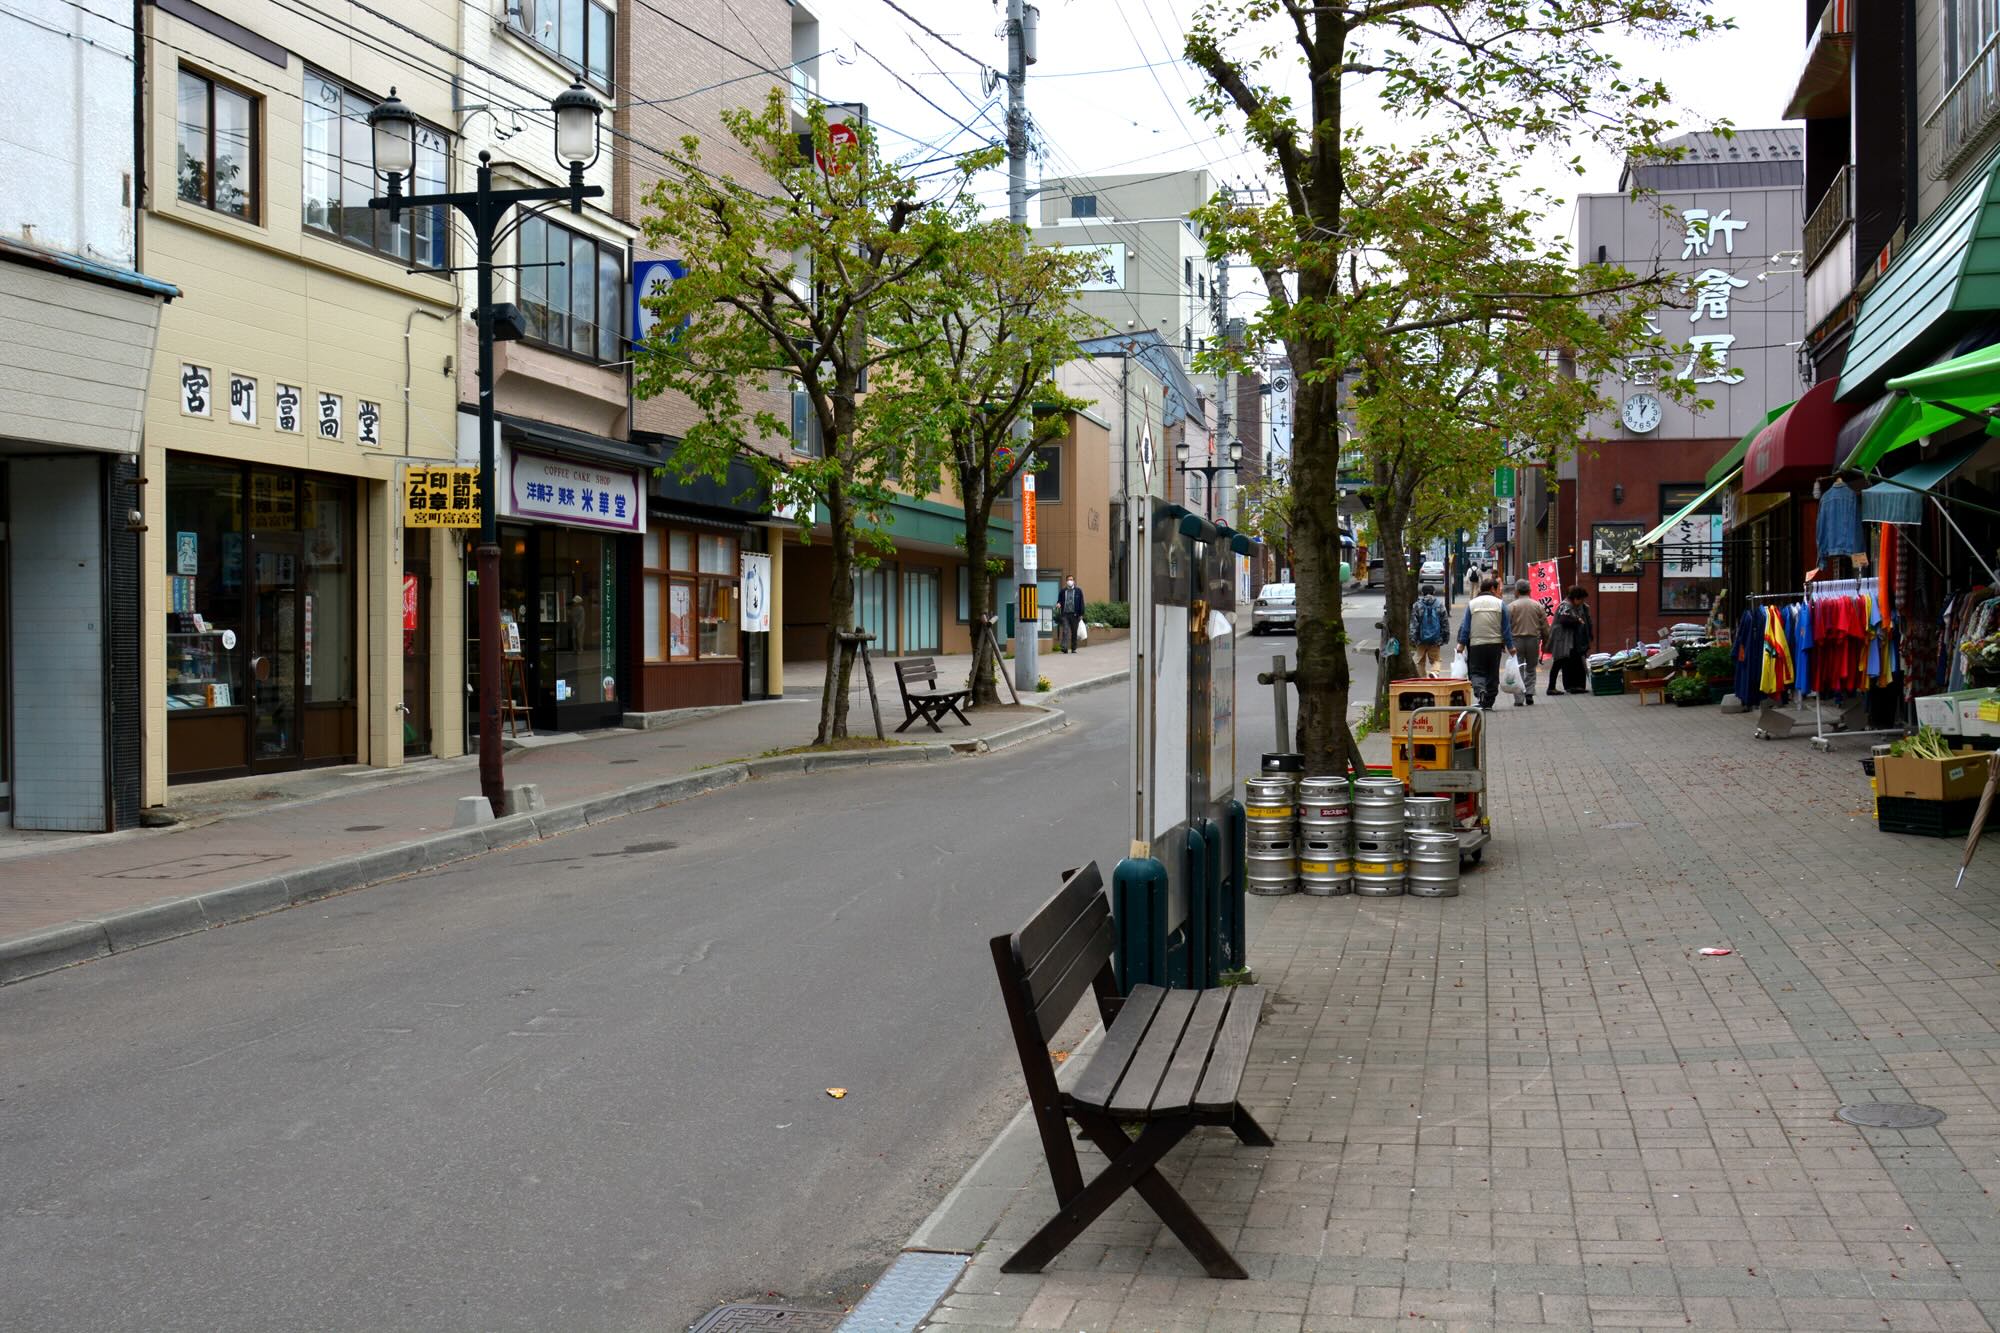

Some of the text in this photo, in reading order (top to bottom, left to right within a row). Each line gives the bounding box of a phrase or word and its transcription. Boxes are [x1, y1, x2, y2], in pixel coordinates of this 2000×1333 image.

[1677, 208, 1750, 385] 新倉屋
[182, 365, 379, 445] 宮町富高堂
[409, 471, 429, 510] ゴム印
[429, 472, 448, 511] 印章
[544, 465, 611, 486] COFFEE CAKE SHOP
[526, 482, 554, 504] 洋菓子
[581, 487, 626, 518] 米華堂
